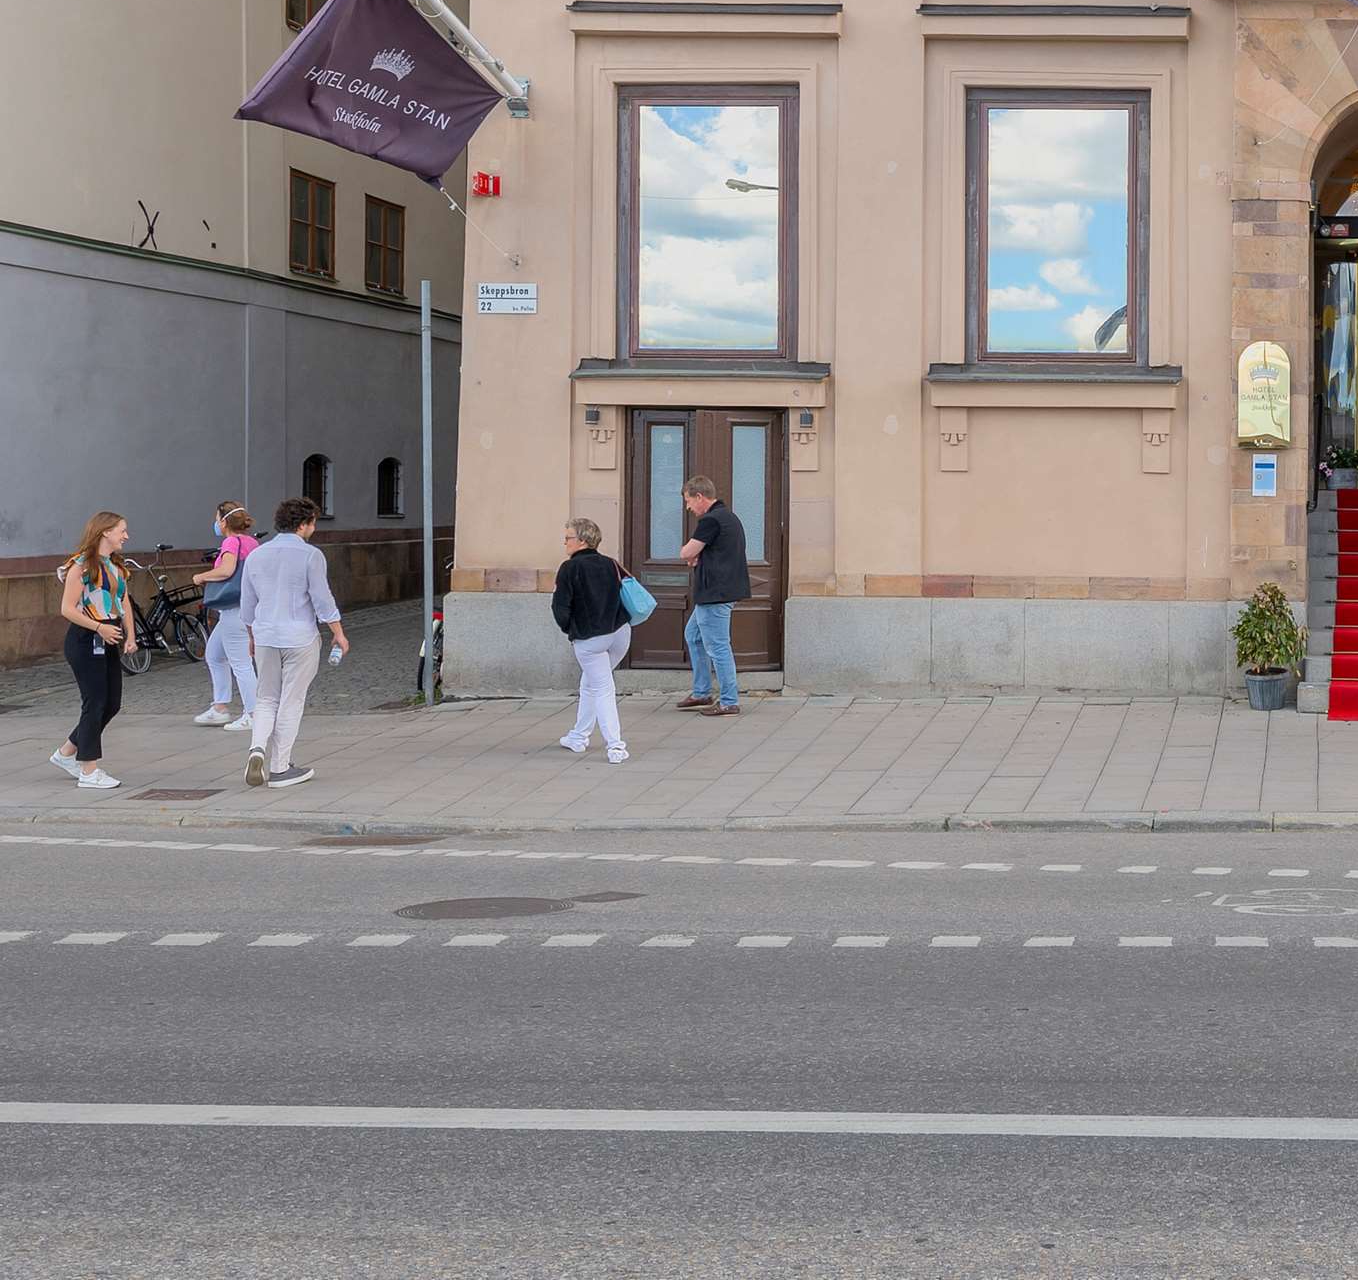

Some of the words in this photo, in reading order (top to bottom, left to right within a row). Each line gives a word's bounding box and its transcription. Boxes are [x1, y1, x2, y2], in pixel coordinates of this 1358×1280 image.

[347, 78, 401, 109] GAMLA
[403, 100, 451, 130] STAN
[480, 285, 529, 298] Skeppsbron
[480, 302, 492, 311] 22
